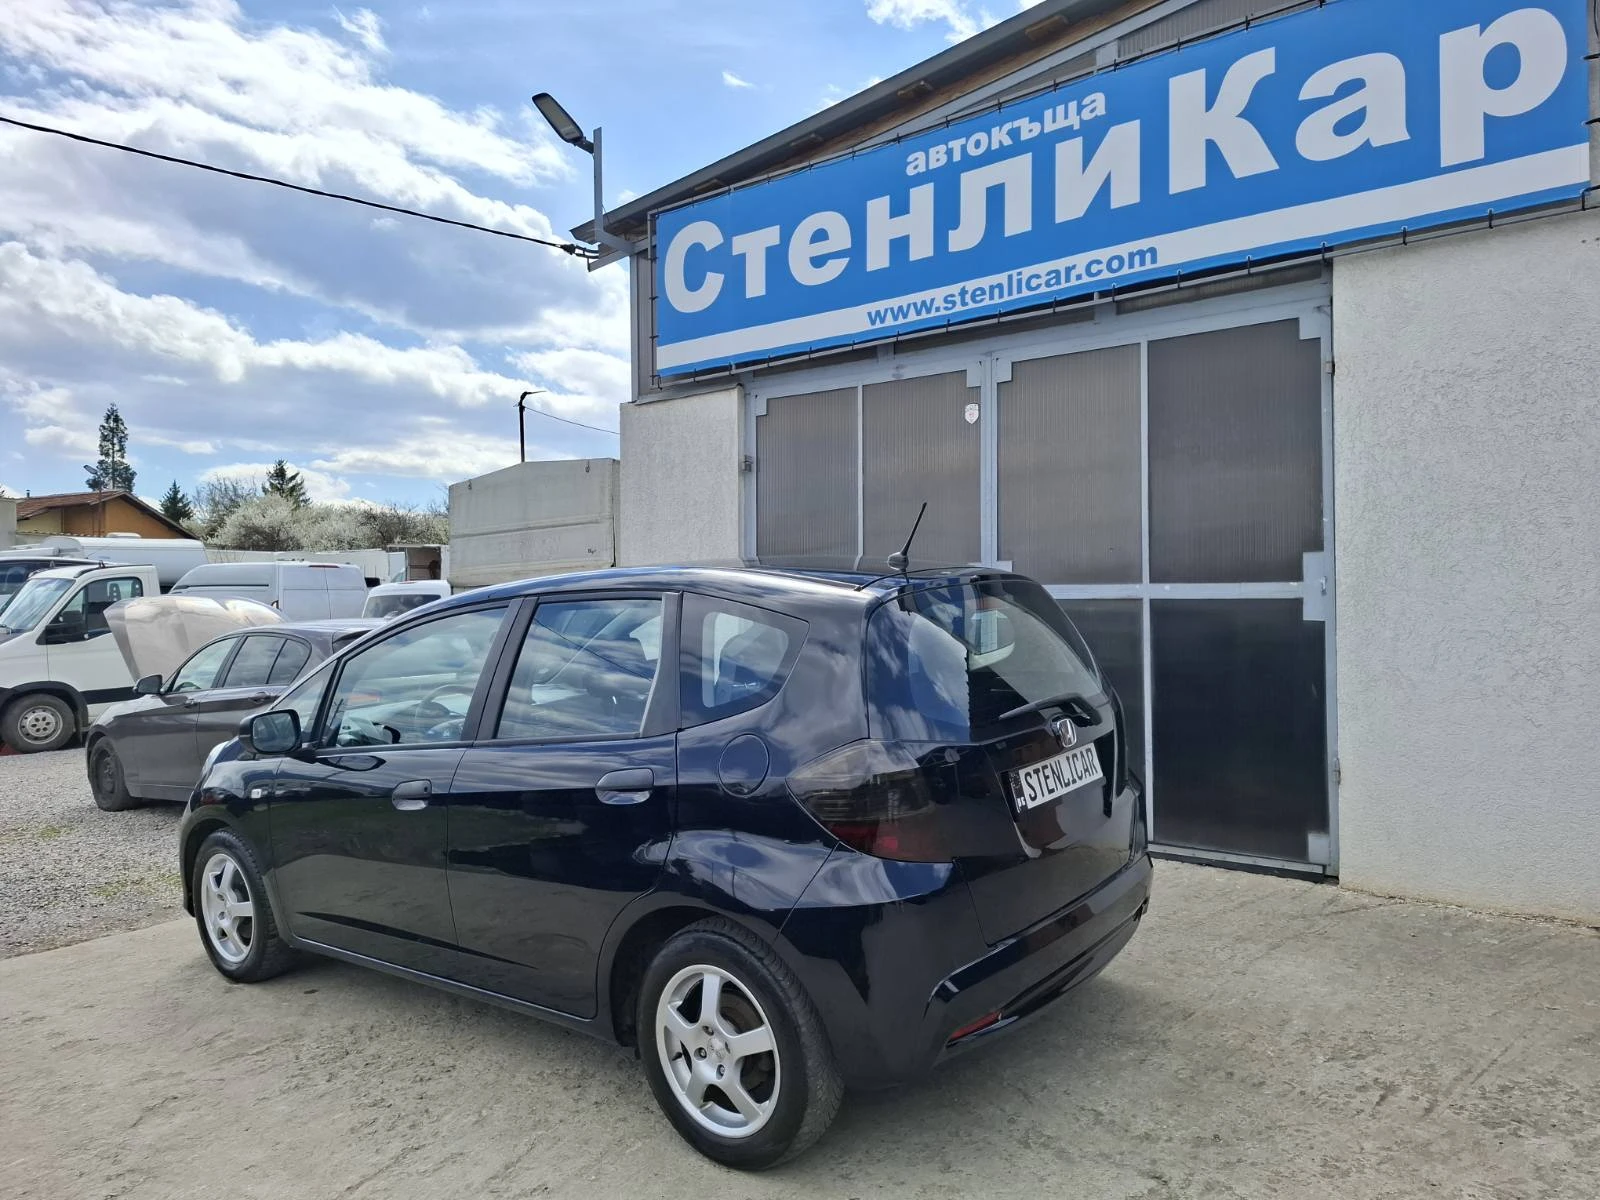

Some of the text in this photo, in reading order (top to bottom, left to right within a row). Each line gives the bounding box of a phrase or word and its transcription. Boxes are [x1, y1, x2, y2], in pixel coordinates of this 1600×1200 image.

[907, 92, 1106, 176] автокъща
[868, 246, 1158, 326] www.stenlicar.com
[1024, 748, 1098, 802] STENLICAR
